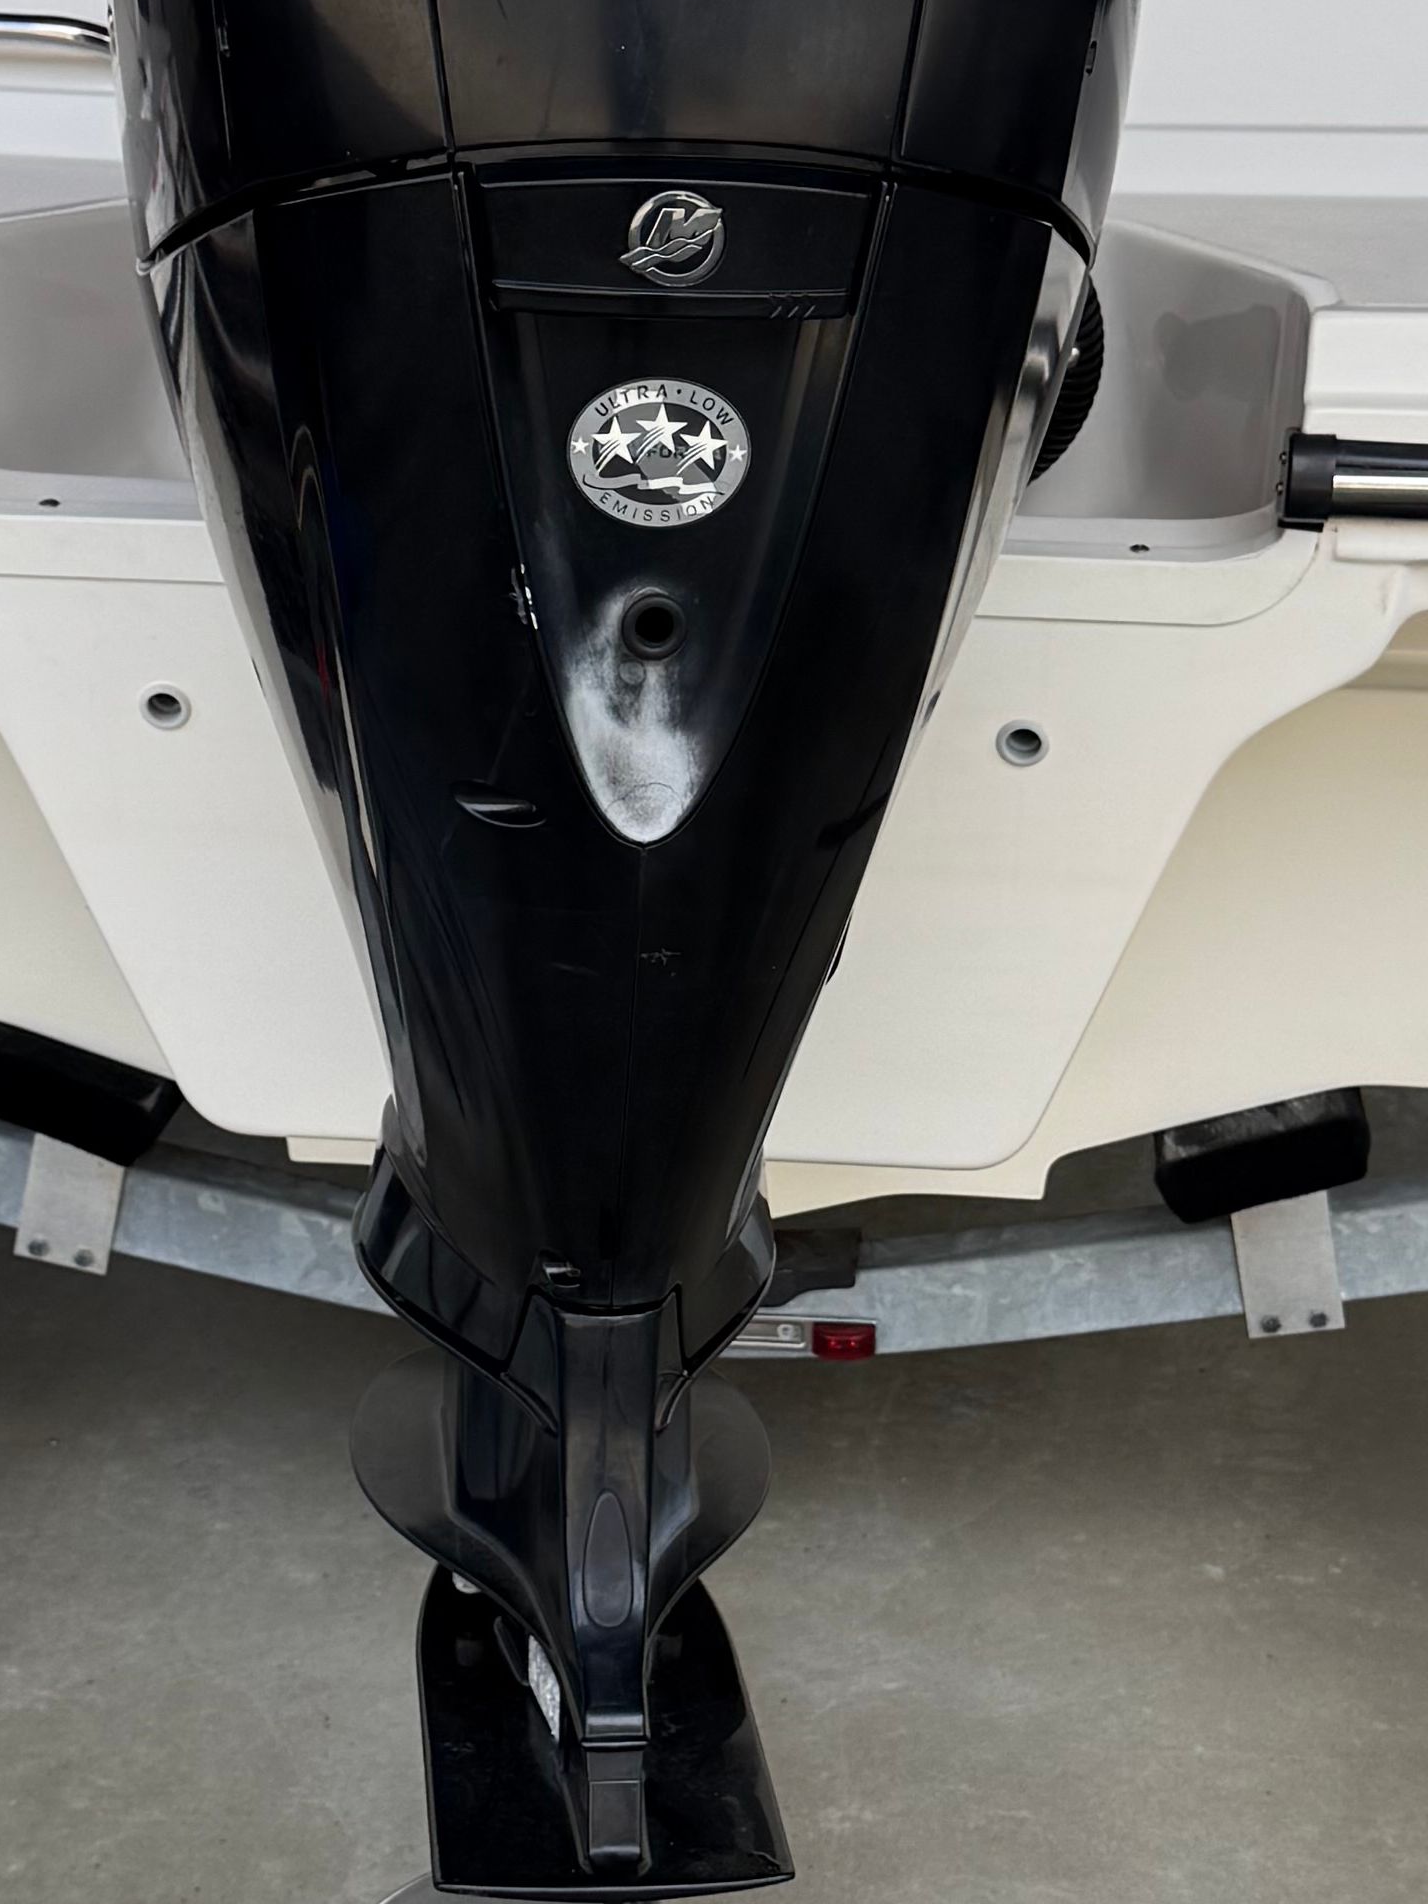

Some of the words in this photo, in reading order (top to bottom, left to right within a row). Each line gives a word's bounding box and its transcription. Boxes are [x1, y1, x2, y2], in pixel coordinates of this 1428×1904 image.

[594, 383, 668, 418] ULTRA
[689, 389, 735, 426] LOW
[599, 491, 716, 523] EMISSION
